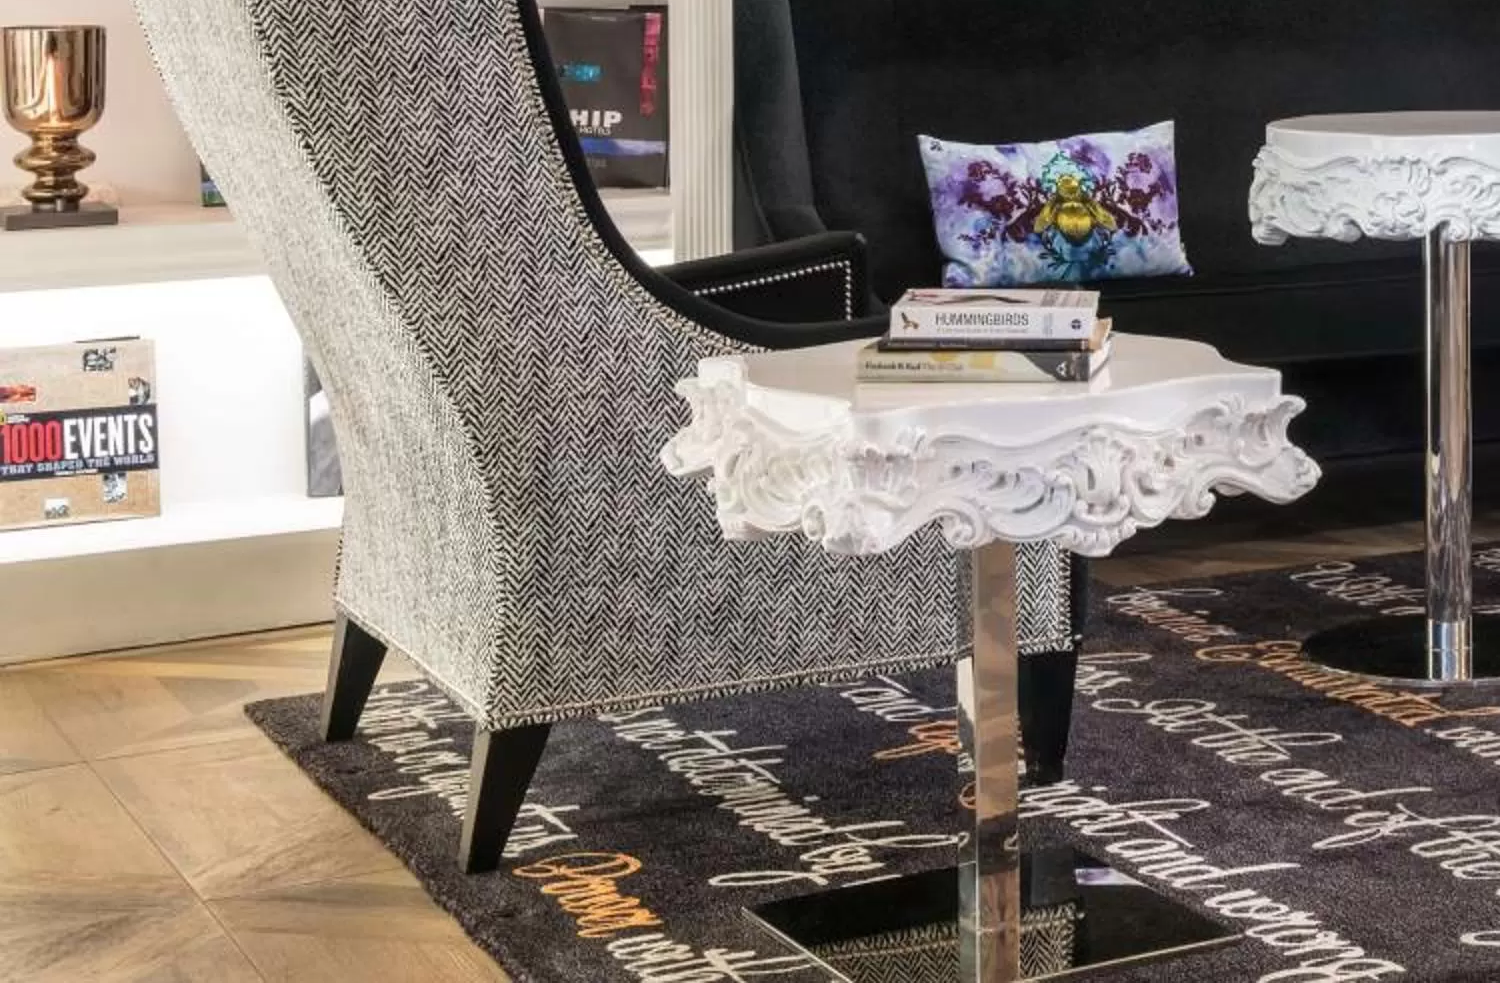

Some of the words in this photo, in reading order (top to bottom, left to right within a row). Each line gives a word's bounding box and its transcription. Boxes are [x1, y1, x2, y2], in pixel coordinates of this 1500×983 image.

[570, 109, 623, 128] HIP
[935, 312, 1029, 326] HUMMINGBIRDS
[0, 420, 62, 465] 1000
[63, 414, 154, 460] EVENTS
[1, 463, 33, 476] THAT
[36, 460, 84, 473] SHAPED
[88, 457, 110, 468] THE
[114, 454, 155, 466] WORLD
[1191, 721, 1343, 766] the
[658, 742, 906, 847] determined
[1017, 779, 1212, 849] right
[1104, 835, 1301, 891] and
[512, 852, 661, 938] Power
